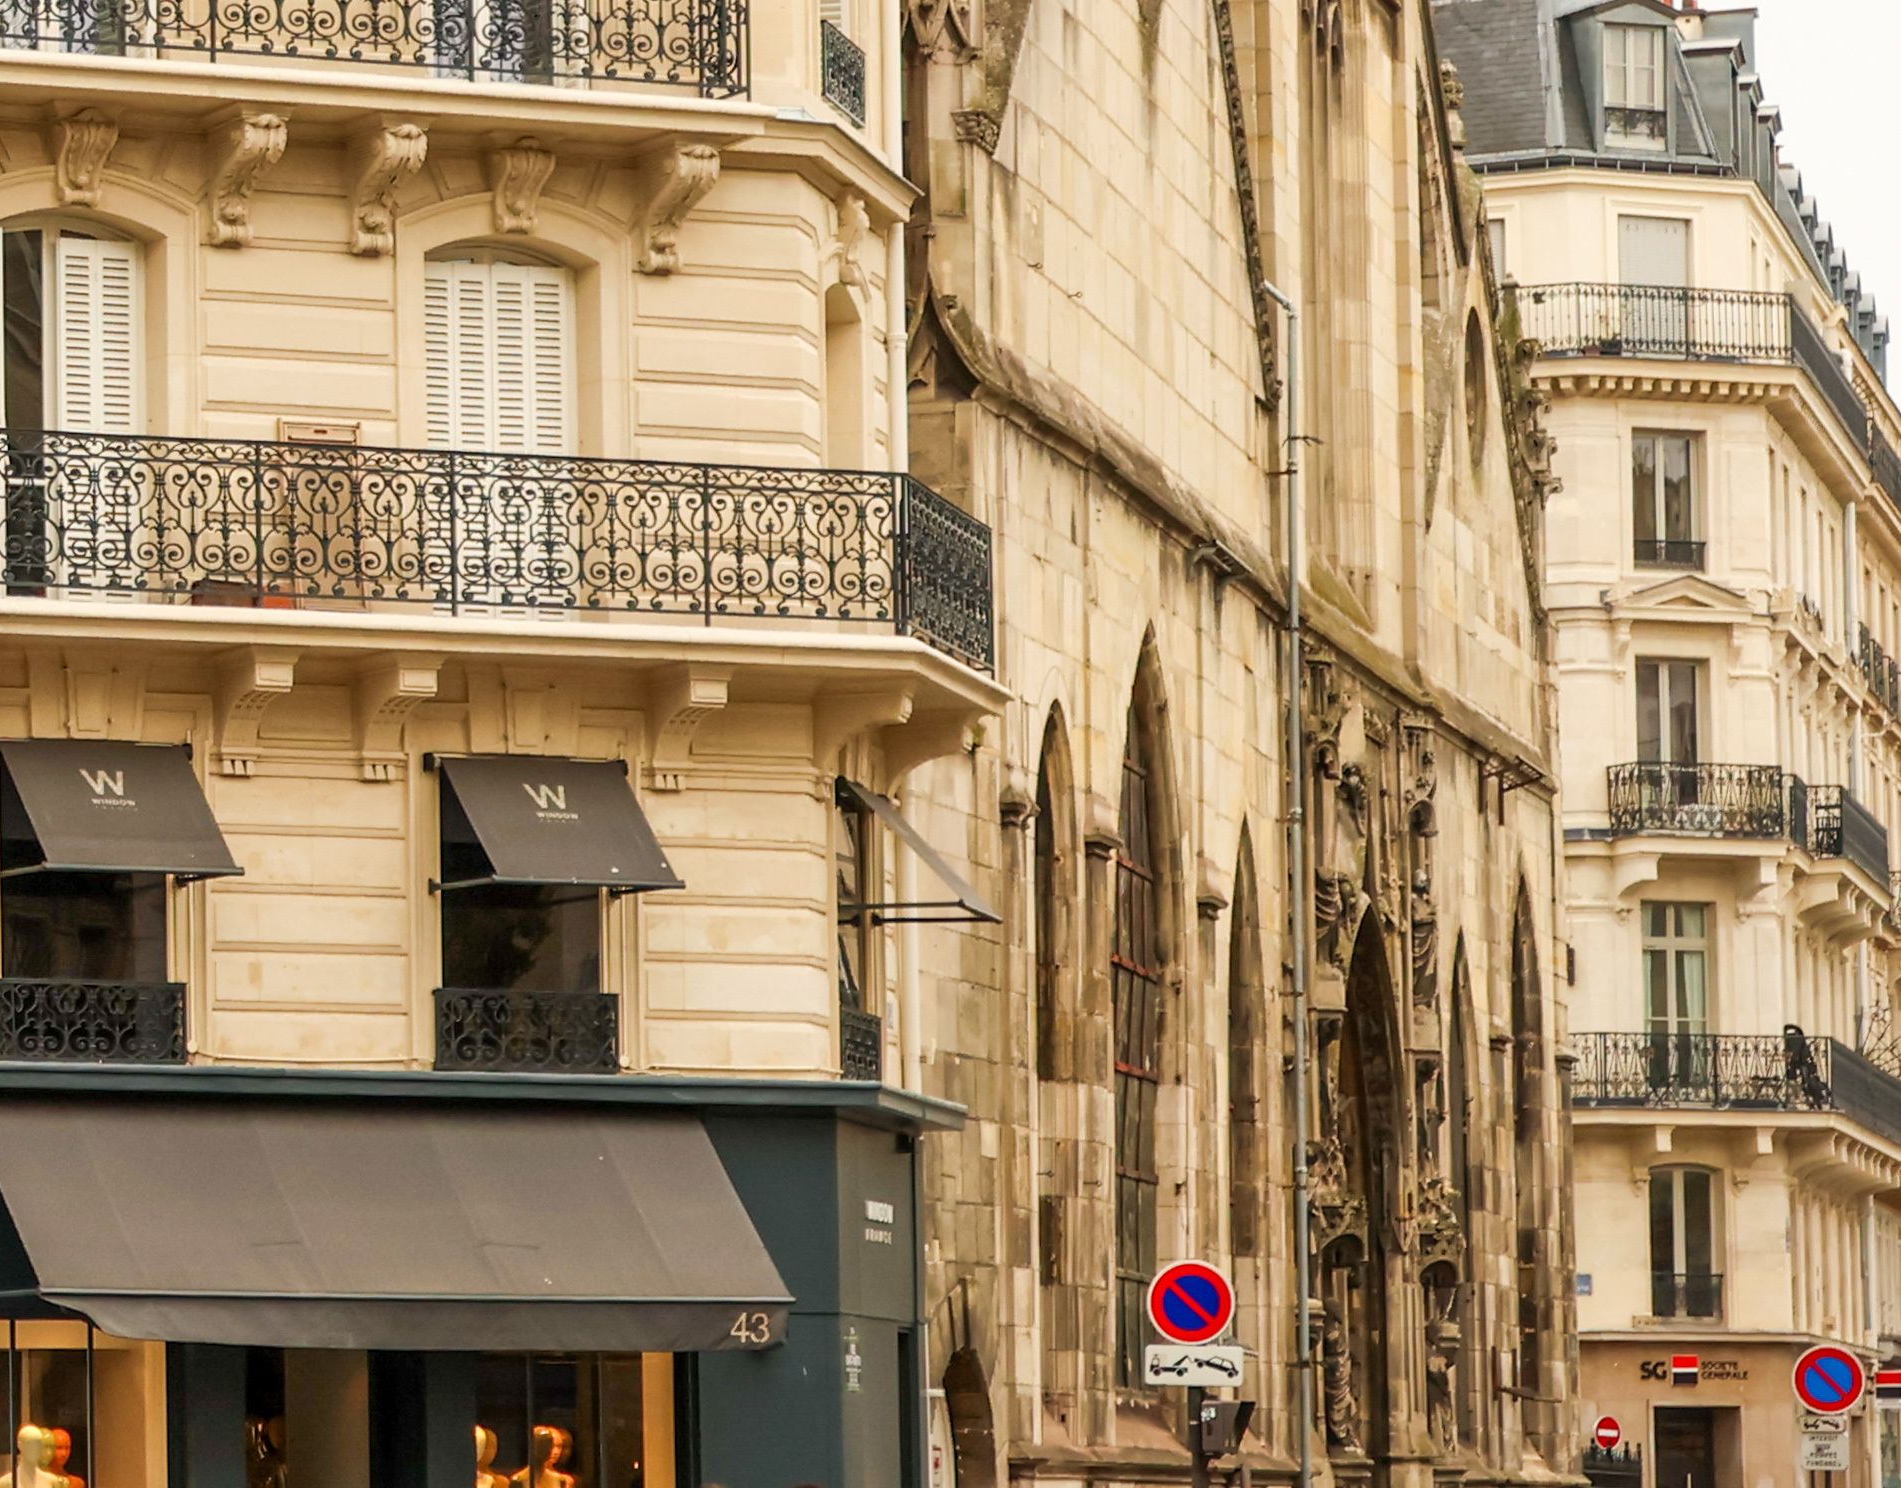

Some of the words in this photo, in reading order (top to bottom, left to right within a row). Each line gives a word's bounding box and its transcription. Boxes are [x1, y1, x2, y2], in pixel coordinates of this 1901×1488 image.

[79, 768, 124, 796] W
[523, 783, 566, 810] W
[730, 1312, 770, 1343] 43
[1640, 1361, 1667, 1380] SG
